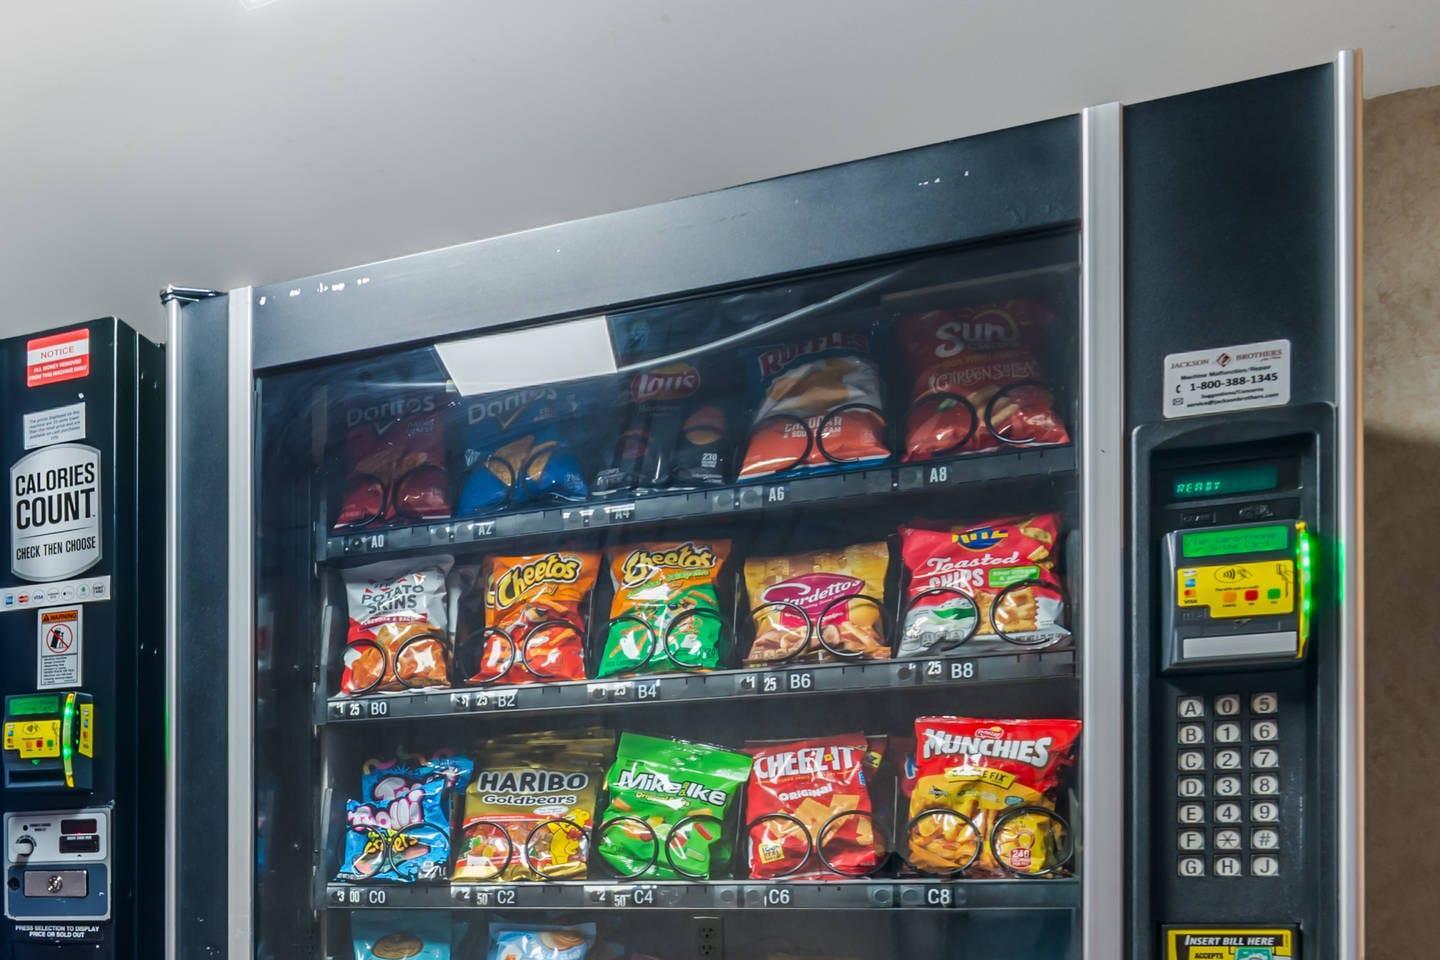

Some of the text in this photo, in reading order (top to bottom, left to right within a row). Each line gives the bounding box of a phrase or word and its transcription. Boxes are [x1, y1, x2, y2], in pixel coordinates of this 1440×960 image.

[935, 321, 1005, 358] Sun
[40, 345, 76, 360] NOTICE
[1170, 359, 1210, 369] JACKSON
[1235, 349, 1282, 360] BROTHERS
[1190, 372, 1278, 392] 1-800-388-1345
[15, 461, 95, 497] CALORIES
[929, 467, 947, 482] A8
[768, 487, 785, 501] A6
[16, 488, 95, 531] COUNT
[615, 509, 631, 522] A4
[478, 521, 492, 535] A2
[16, 535, 97, 561] CHECK THEN CHOOSE
[371, 535, 385, 549] A0
[622, 541, 717, 588] Cheetos
[926, 552, 1020, 574] Toasted
[496, 553, 581, 610] Cheetos
[929, 569, 985, 590] CHIPS
[361, 584, 425, 605] POTATO
[367, 594, 417, 614] SKINS
[927, 661, 974, 679] 25 B8
[764, 673, 811, 691] 25 B6
[638, 685, 657, 699] B4
[498, 694, 516, 707] B2
[1260, 698, 1270, 712] 5
[371, 702, 387, 715] B0
[1184, 701, 1197, 715] A
[1186, 728, 1196, 741] B
[1223, 727, 1230, 740] 1
[1259, 725, 1270, 738] 6
[923, 729, 1053, 768] MUNCHIES
[1185, 754, 1196, 768] C
[1222, 753, 1232, 767] 2
[1260, 752, 1270, 765] 7
[478, 771, 588, 793] HARIBO
[618, 770, 727, 806] Mike Ike
[1186, 781, 1197, 794] D
[1222, 780, 1232, 793] 3
[1260, 778, 1270, 792] 8
[482, 794, 577, 806] Goldbears
[1186, 807, 1196, 820] E
[1222, 806, 1232, 819] 4
[1260, 805, 1270, 818] 9
[1186, 834, 1196, 847] F
[1185, 860, 1197, 874] G
[1222, 860, 1233, 873] H
[1260, 860, 1270, 873] J
[477, 890, 515, 905] 50 C2
[614, 889, 654, 907] 50 C4
[769, 889, 790, 904] C6
[927, 889, 950, 904] C8
[1184, 934, 1275, 946] INSERT BILL HERE
